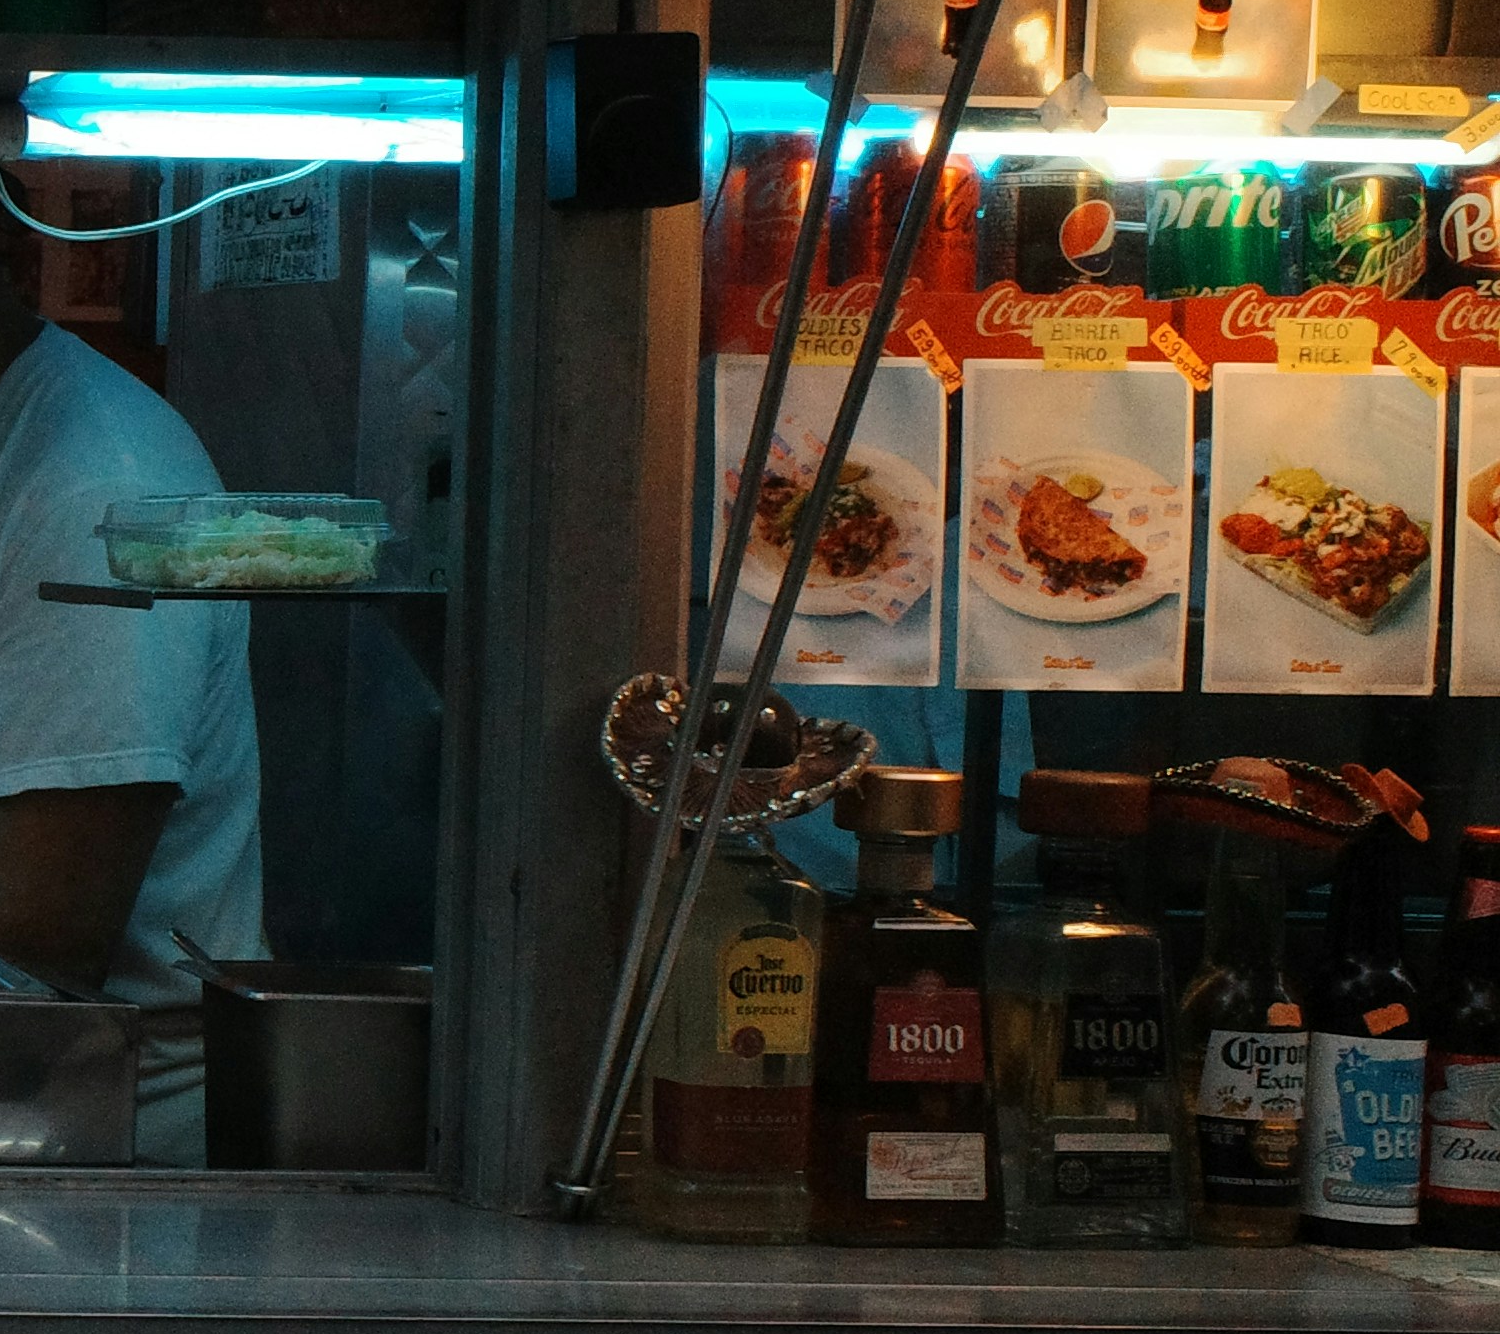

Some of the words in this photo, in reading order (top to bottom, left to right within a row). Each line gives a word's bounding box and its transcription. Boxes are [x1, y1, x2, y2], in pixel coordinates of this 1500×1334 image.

[797, 317, 862, 337] OLDIES
[800, 338, 855, 358] TACO
[729, 967, 804, 1000] Cuervo
[736, 1004, 799, 1016] ESPECIAL
[886, 1022, 965, 1054] 1800
[1070, 1018, 1160, 1053] 1800
